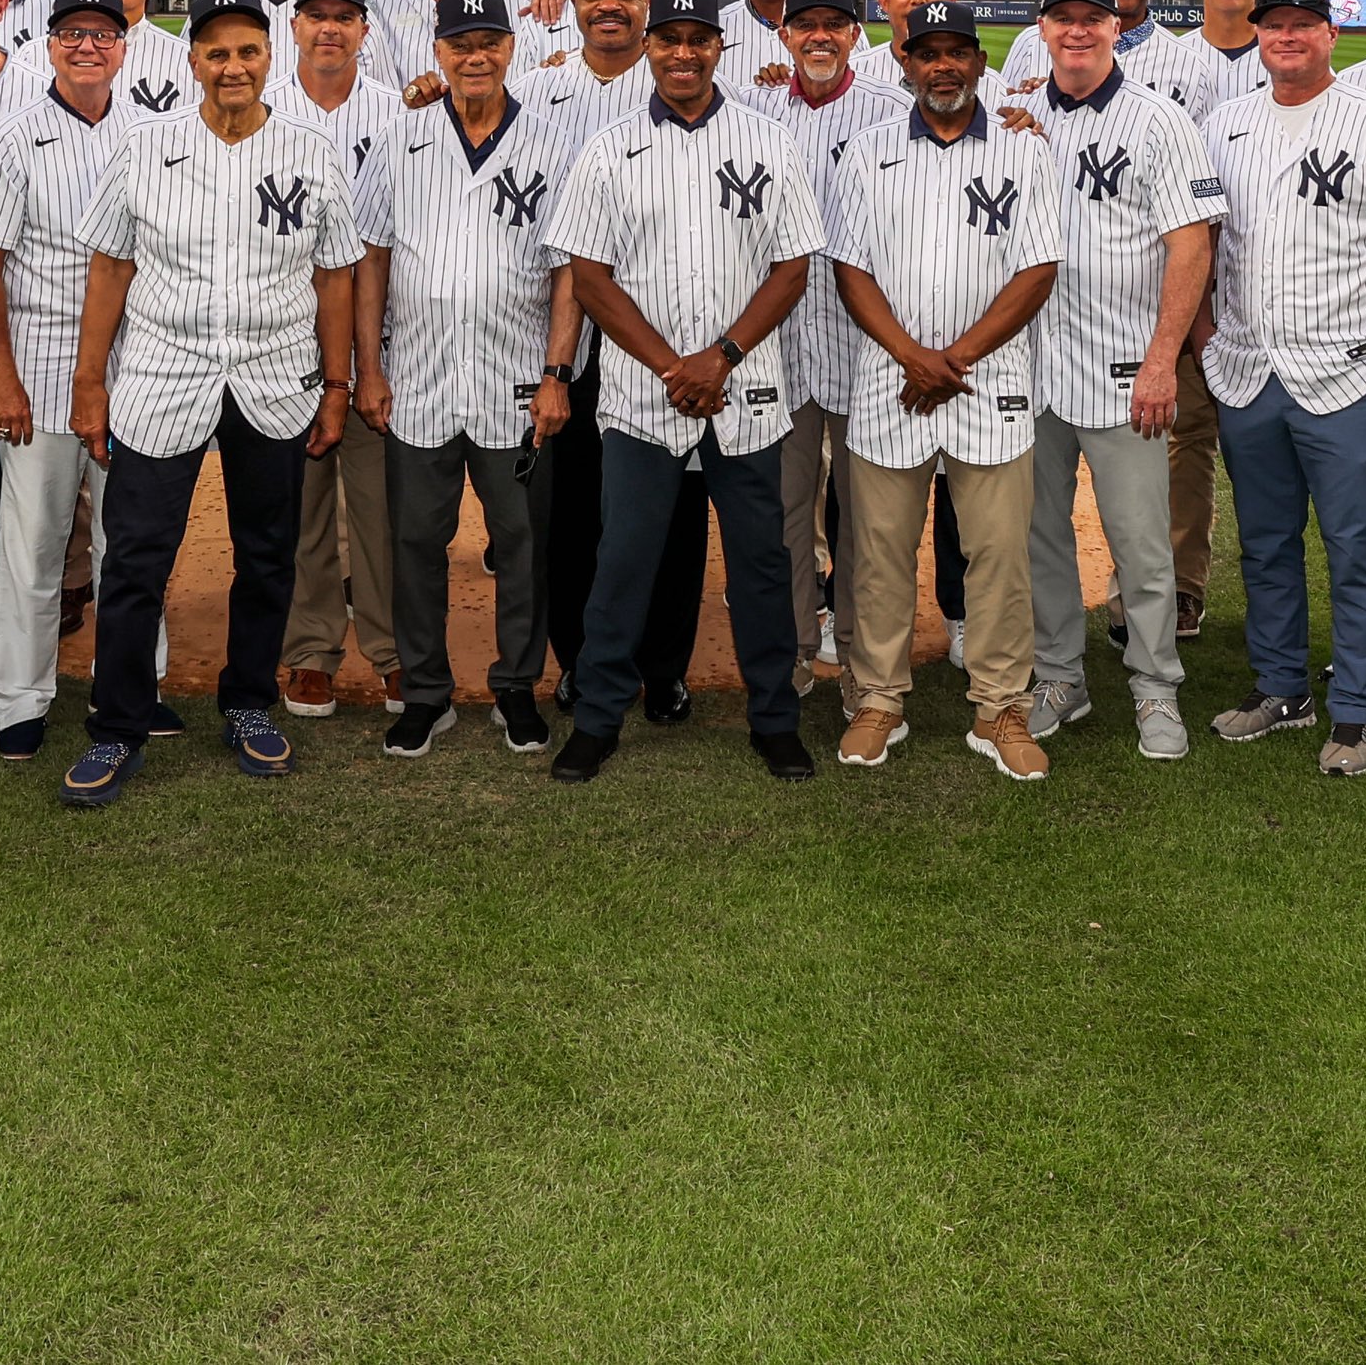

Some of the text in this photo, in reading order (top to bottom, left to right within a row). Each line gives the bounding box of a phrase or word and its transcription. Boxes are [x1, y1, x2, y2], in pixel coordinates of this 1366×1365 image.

[926, 2, 948, 24] NY
[493, 166, 548, 227] NY
[715, 158, 773, 219] NY
[1075, 142, 1132, 201] NY
[1191, 180, 1220, 191] STARR
[1296, 147, 1356, 207] NY
[255, 174, 309, 235] NY
[964, 176, 1019, 236] NY
